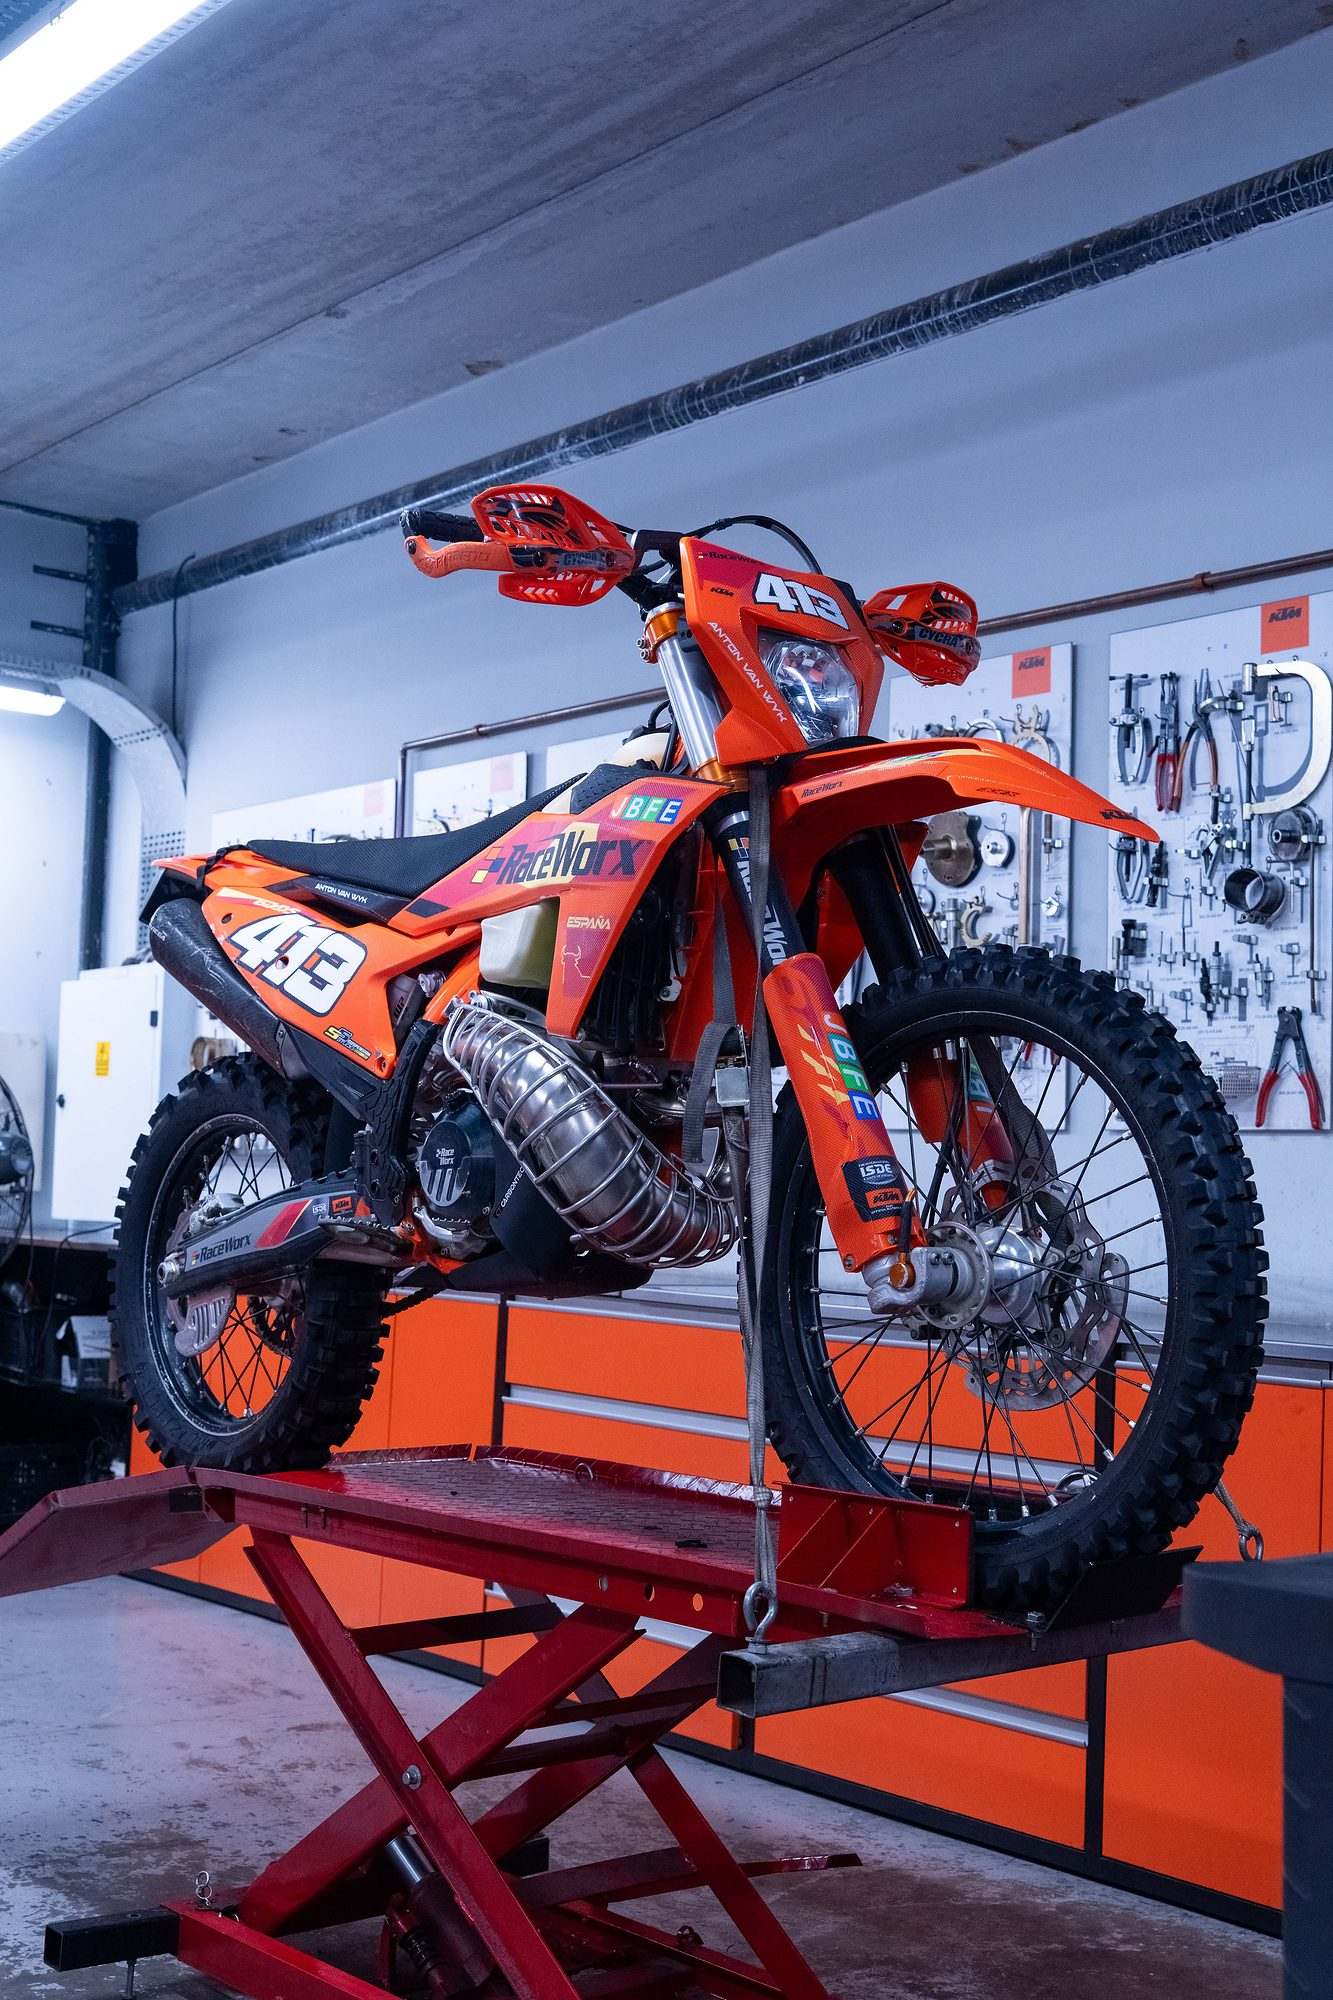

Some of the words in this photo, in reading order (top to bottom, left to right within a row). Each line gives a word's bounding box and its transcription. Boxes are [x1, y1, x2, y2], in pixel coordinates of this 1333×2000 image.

[753, 571, 850, 631] 413
[1268, 607, 1303, 623] KTM
[707, 621, 744, 662] ANTON
[743, 663, 764, 689] VAN
[762, 690, 788, 723] WYK
[1018, 655, 1046, 671] KTM
[610, 796, 682, 824] JBFE
[496, 829, 652, 885] RaceWorx
[315, 883, 337, 895] ANTON
[337, 888, 351, 899] VAN
[351, 893, 369, 904] WYK
[566, 915, 612, 930] ESPAÑA
[226, 912, 368, 1017] 413
[823, 1013, 879, 1120] JBFE
[199, 1233, 252, 1263] RaceWorx
